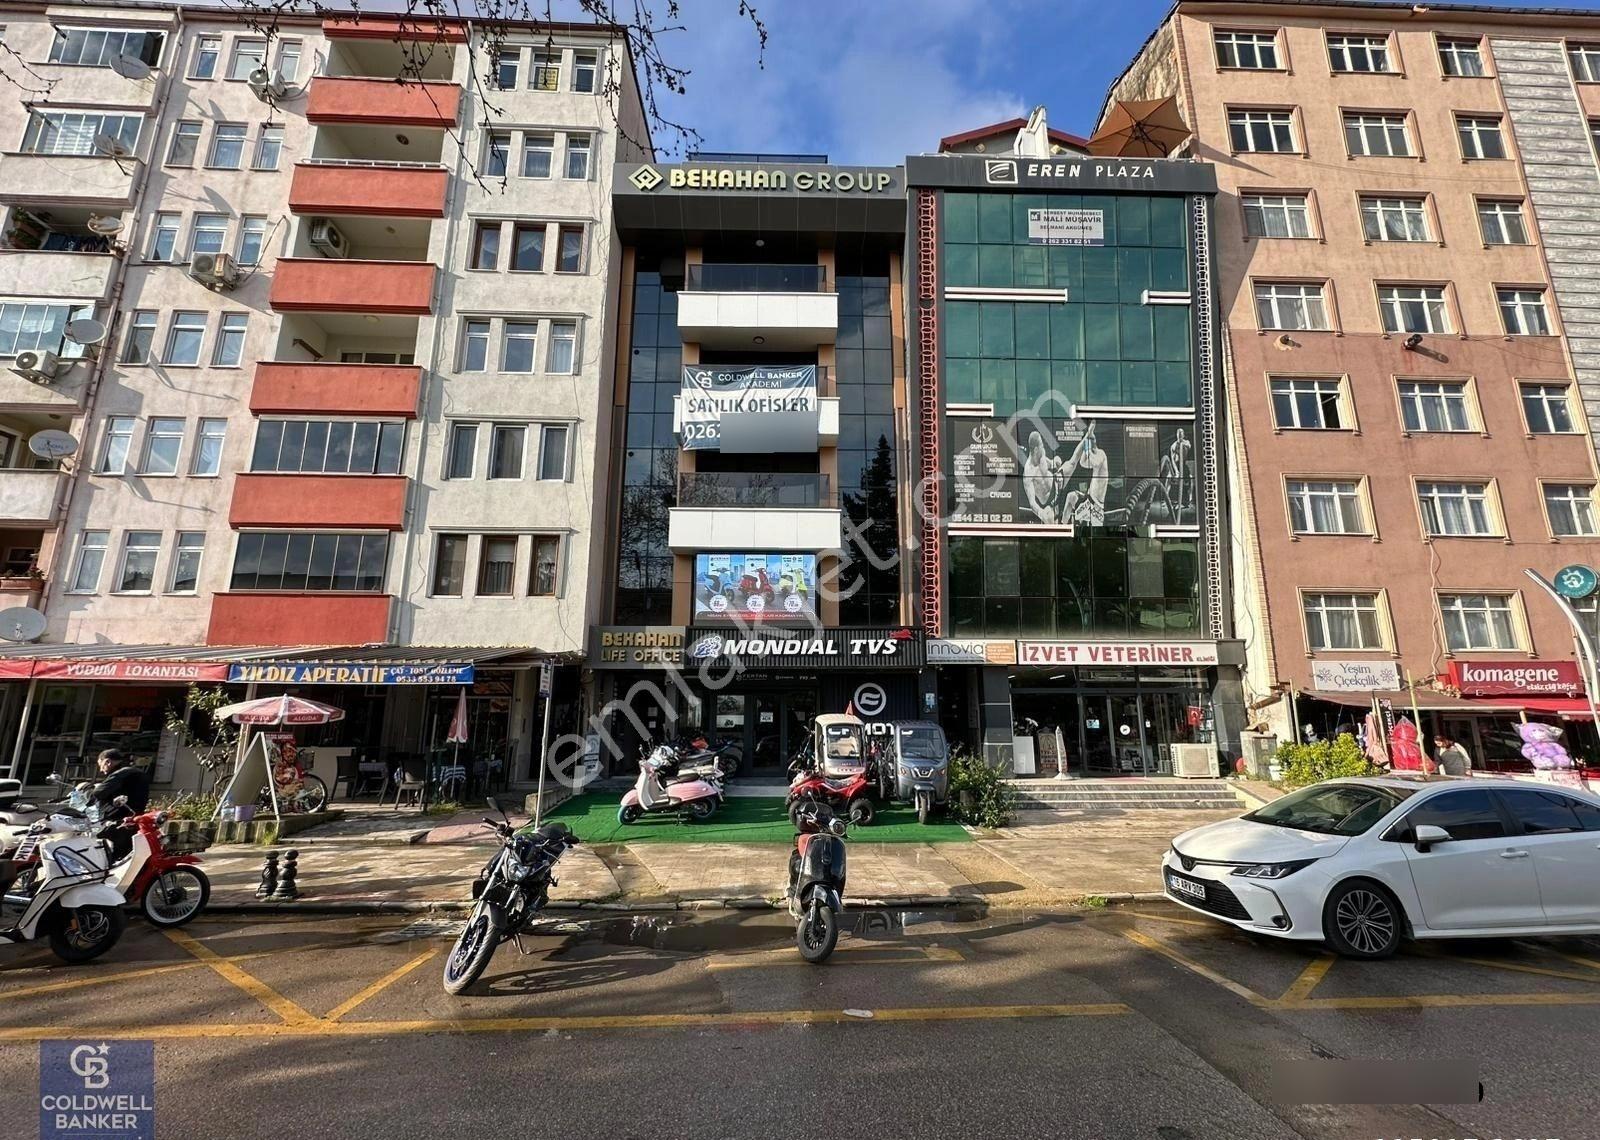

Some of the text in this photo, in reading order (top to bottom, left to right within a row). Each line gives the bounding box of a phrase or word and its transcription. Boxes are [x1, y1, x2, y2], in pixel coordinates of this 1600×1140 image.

[1027, 164, 1154, 178] EREN PLAZA
[670, 169, 891, 191] BEKAHAN GROUP
[718, 371, 802, 382] COLDWELL BANKER
[740, 381, 782, 389] AKADEMİ
[688, 395, 809, 413] SATILIK OFİSLER
[990, 514, 1000, 522] 02
[1002, 514, 1013, 522] 20
[602, 632, 681, 647] BEKAHAN
[724, 639, 897, 655] MONDIAL TVS
[928, 642, 984, 655] innovia
[1023, 643, 1078, 661] İZVET
[1088, 644, 1192, 662] VETERİNER
[601, 650, 680, 662] LIFE OFFICE
[125, 665, 199, 676] LOKANTASI
[240, 666, 296, 682] YILDIZ
[299, 665, 388, 683] APERATİF
[1340, 663, 1371, 674] Yeşim
[1462, 663, 1559, 687] komagene
[1334, 675, 1380, 688] Çiçekçilik
